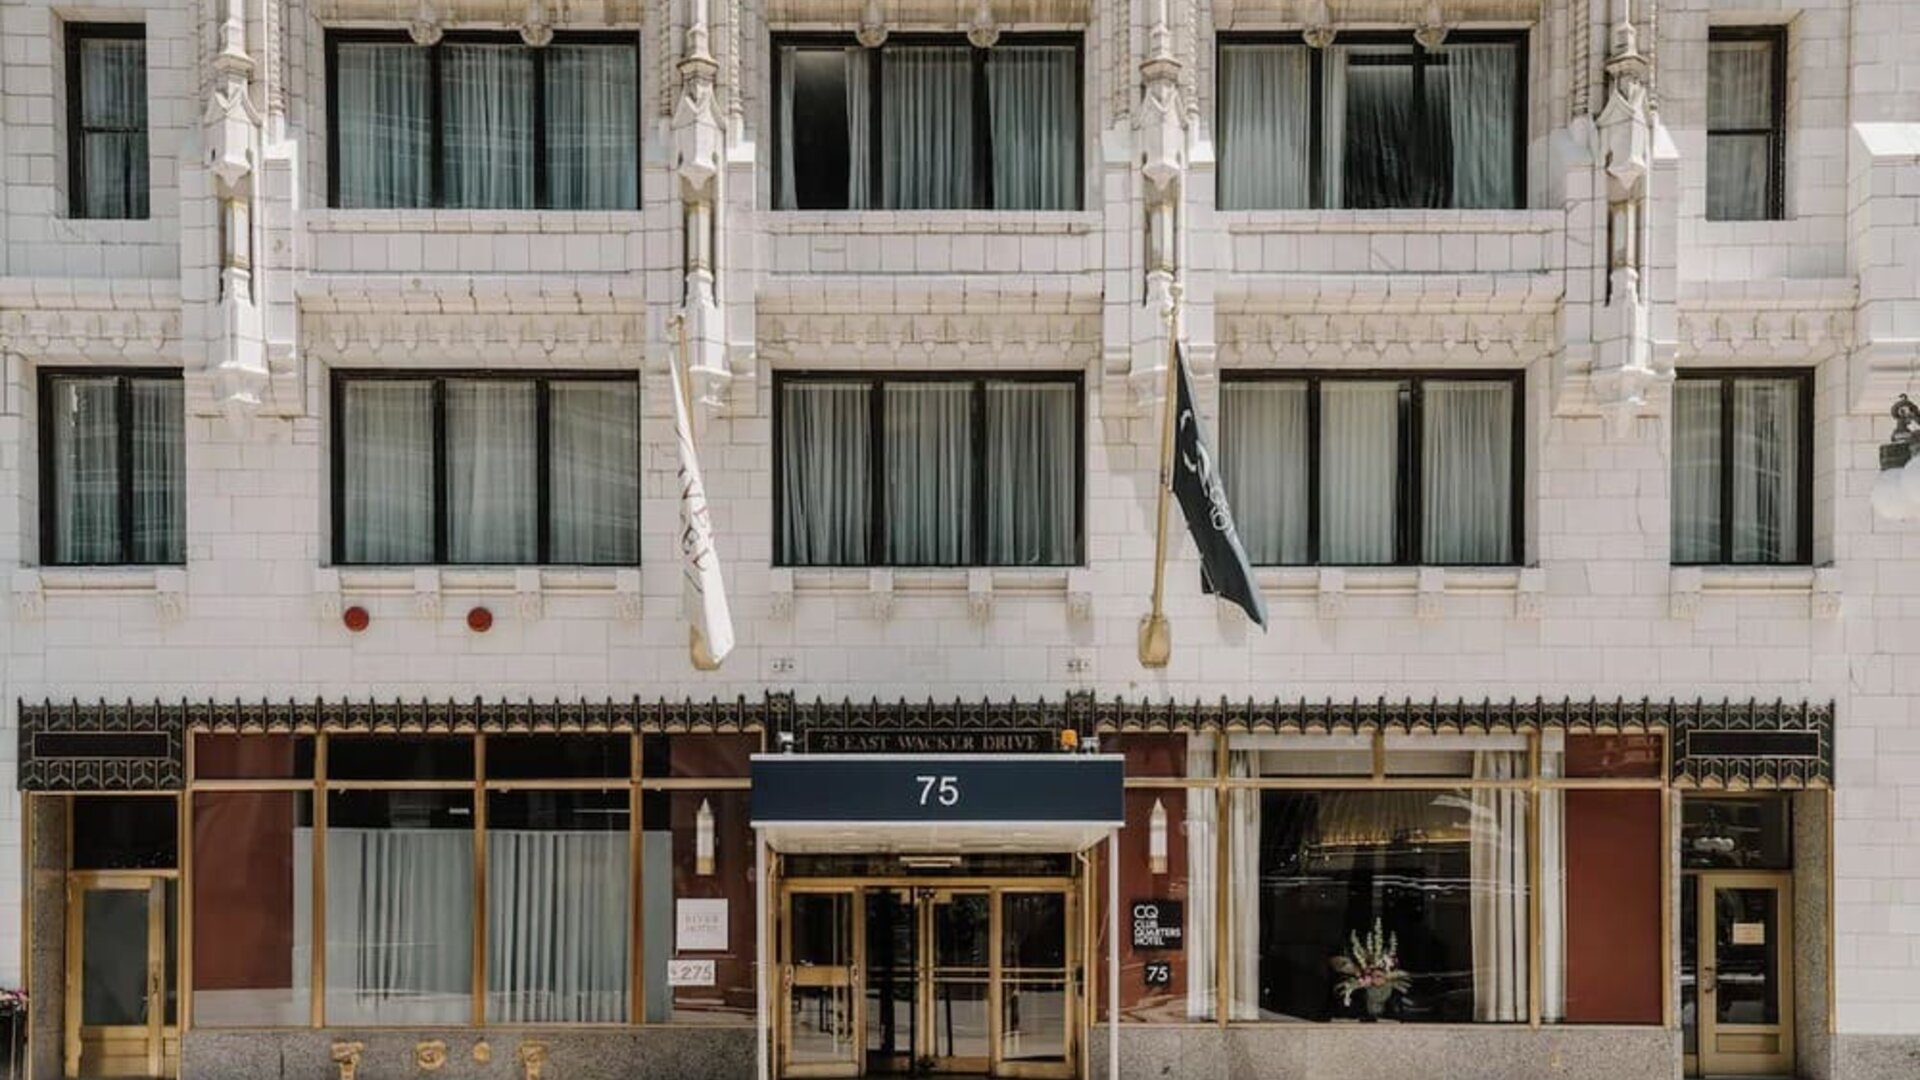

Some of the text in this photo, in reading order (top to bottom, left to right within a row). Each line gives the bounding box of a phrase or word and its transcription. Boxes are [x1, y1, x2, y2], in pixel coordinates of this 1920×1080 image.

[822, 735, 1040, 750] 75 EAST WACKER DRIVE
[916, 775, 959, 806] 75
[1133, 904, 1159, 919] CQ
[1133, 927, 1182, 937] QUARTERS
[1133, 936, 1165, 945] HOTEL
[1146, 965, 1169, 982] 75
